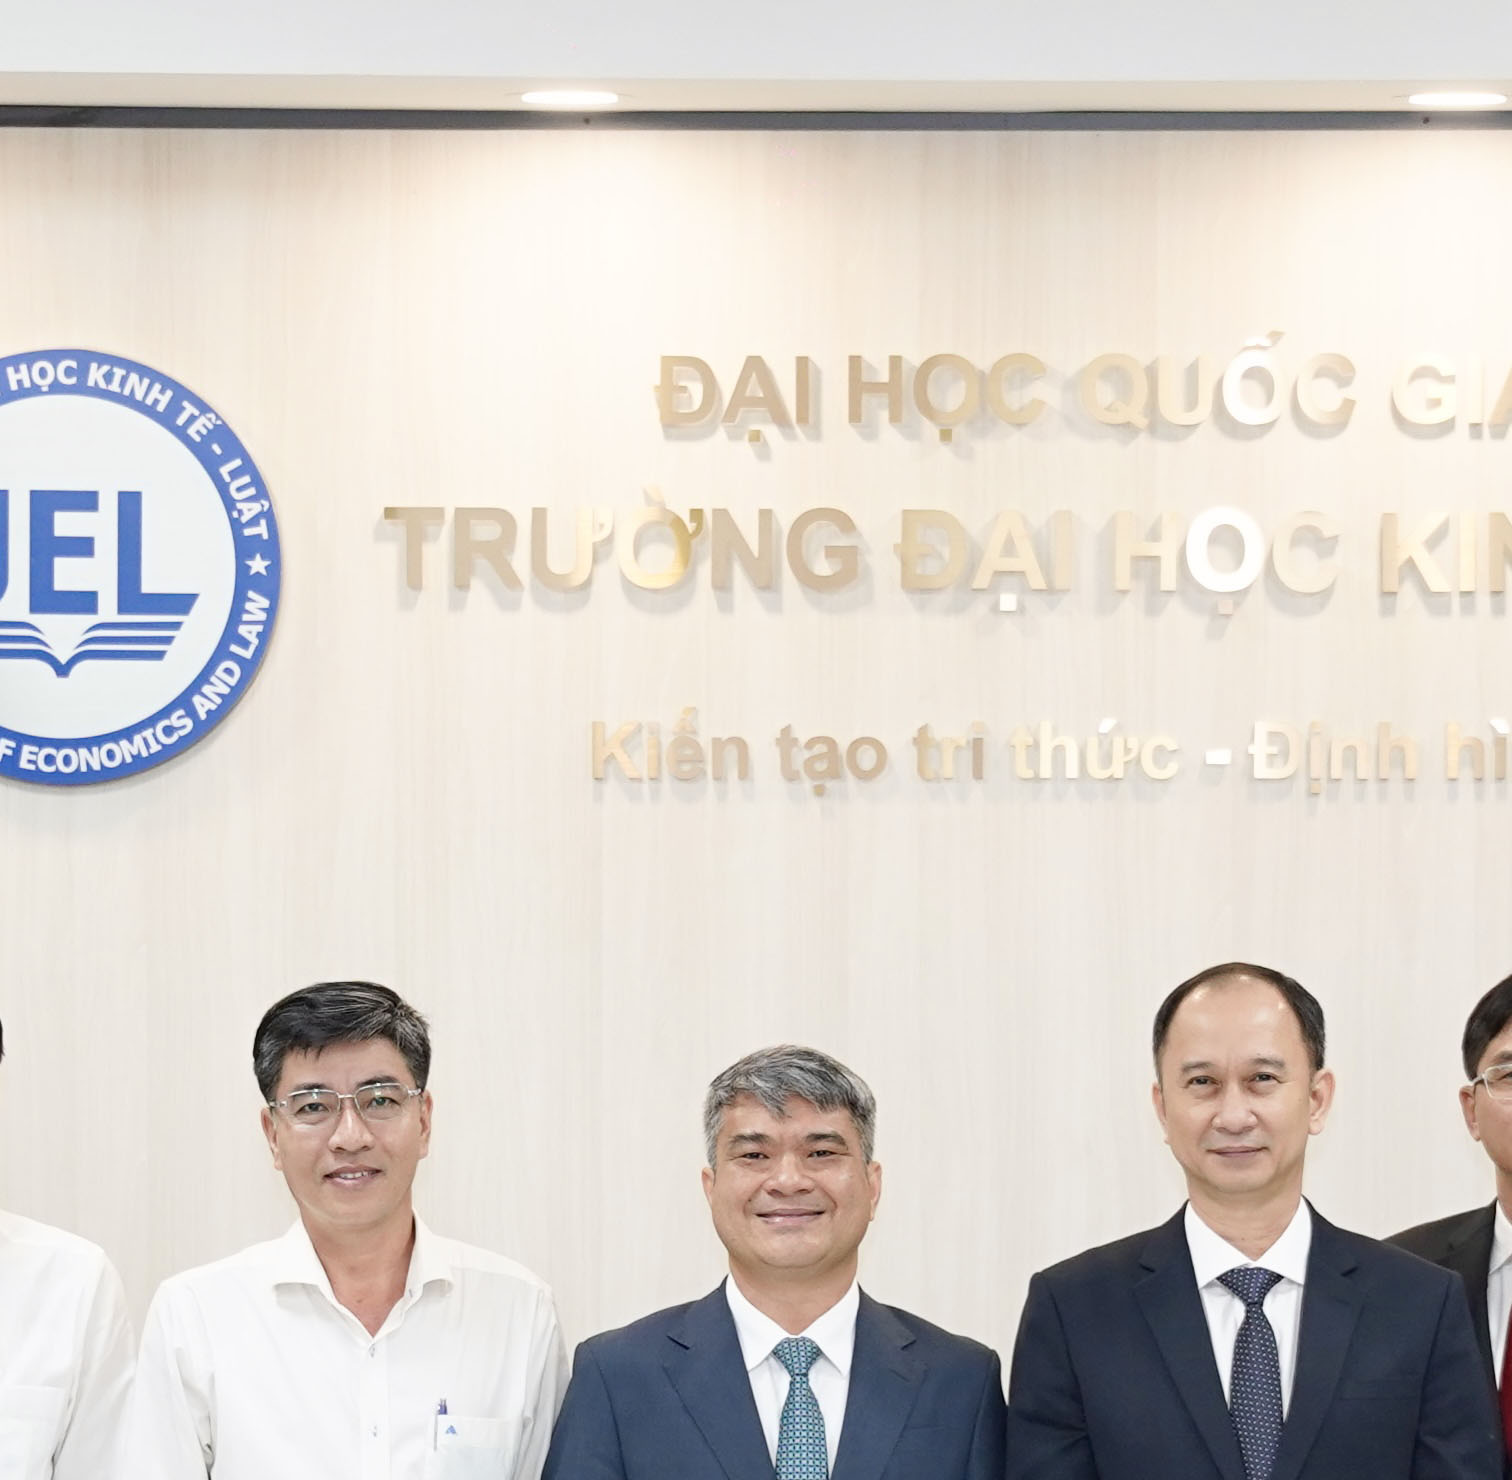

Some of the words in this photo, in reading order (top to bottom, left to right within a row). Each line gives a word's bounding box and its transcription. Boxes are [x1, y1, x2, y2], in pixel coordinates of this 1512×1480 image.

[6, 359, 78, 392] HỌC
[87, 362, 173, 413] KINH
[175, 400, 223, 442] TẾ
[219, 458, 270, 540] LUẬT
[654, 355, 809, 443] ĐẠI
[848, 353, 1046, 443] HỌC
[1080, 330, 1357, 430] QUỐC
[384, 484, 860, 592] TRƯỜNG
[893, 509, 1073, 612] ĐẠI
[1114, 507, 1340, 615] HỌC
[19, 708, 193, 774] ECONOMICS
[191, 660, 241, 720] AND
[229, 590, 270, 659] LAW
[591, 706, 749, 781] Kiến
[776, 725, 888, 796] tạo
[1010, 717, 1181, 780] thức
[1205, 748, 1232, 764] -
[1248, 720, 1418, 795] Định
